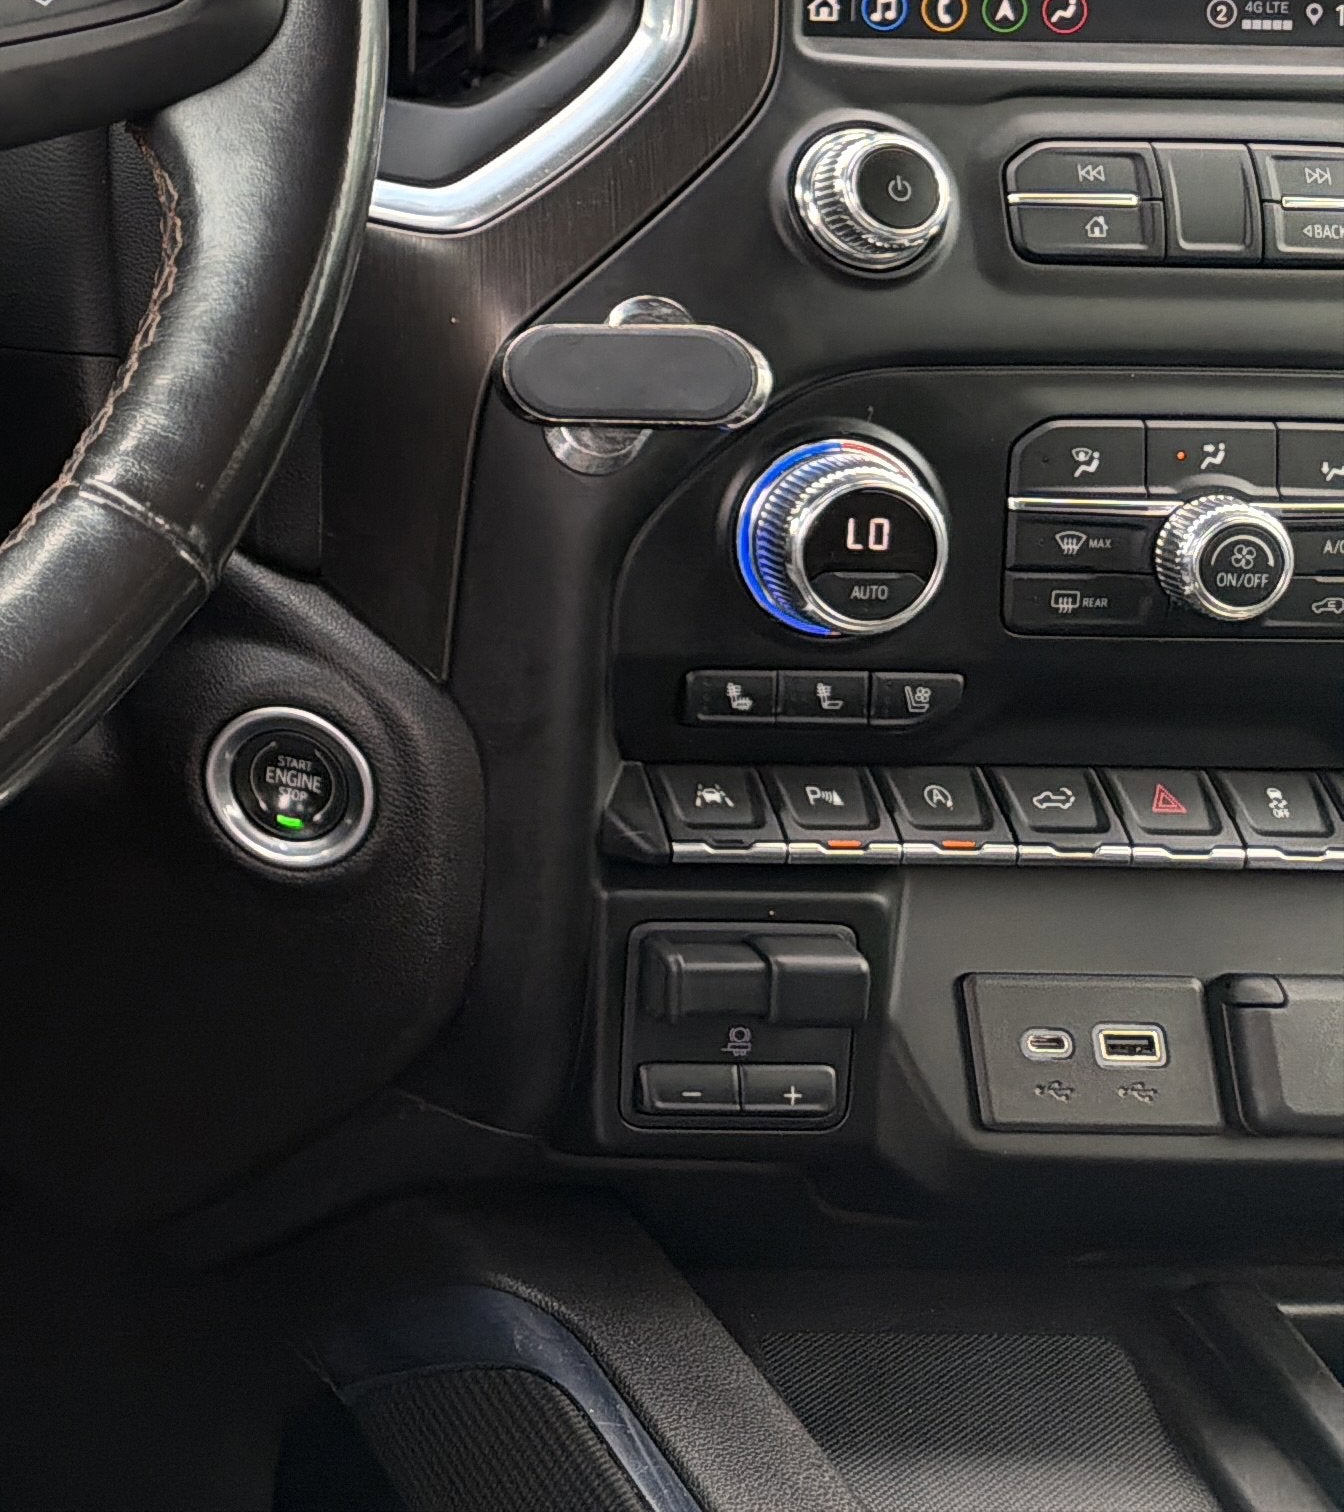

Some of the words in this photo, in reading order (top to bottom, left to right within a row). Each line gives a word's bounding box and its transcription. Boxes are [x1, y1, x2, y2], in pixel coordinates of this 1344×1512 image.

[1244, 0, 1263, 14] 4G
[1266, 1, 1290, 14] LTE
[1089, 538, 1112, 549] MAX
[1216, 572, 1270, 589] ON/OFF
[850, 585, 889, 600] AUTO
[1082, 596, 1109, 608] REAR
[277, 755, 313, 772] START
[265, 766, 322, 794] ENGINE
[278, 785, 309, 802] STOP
